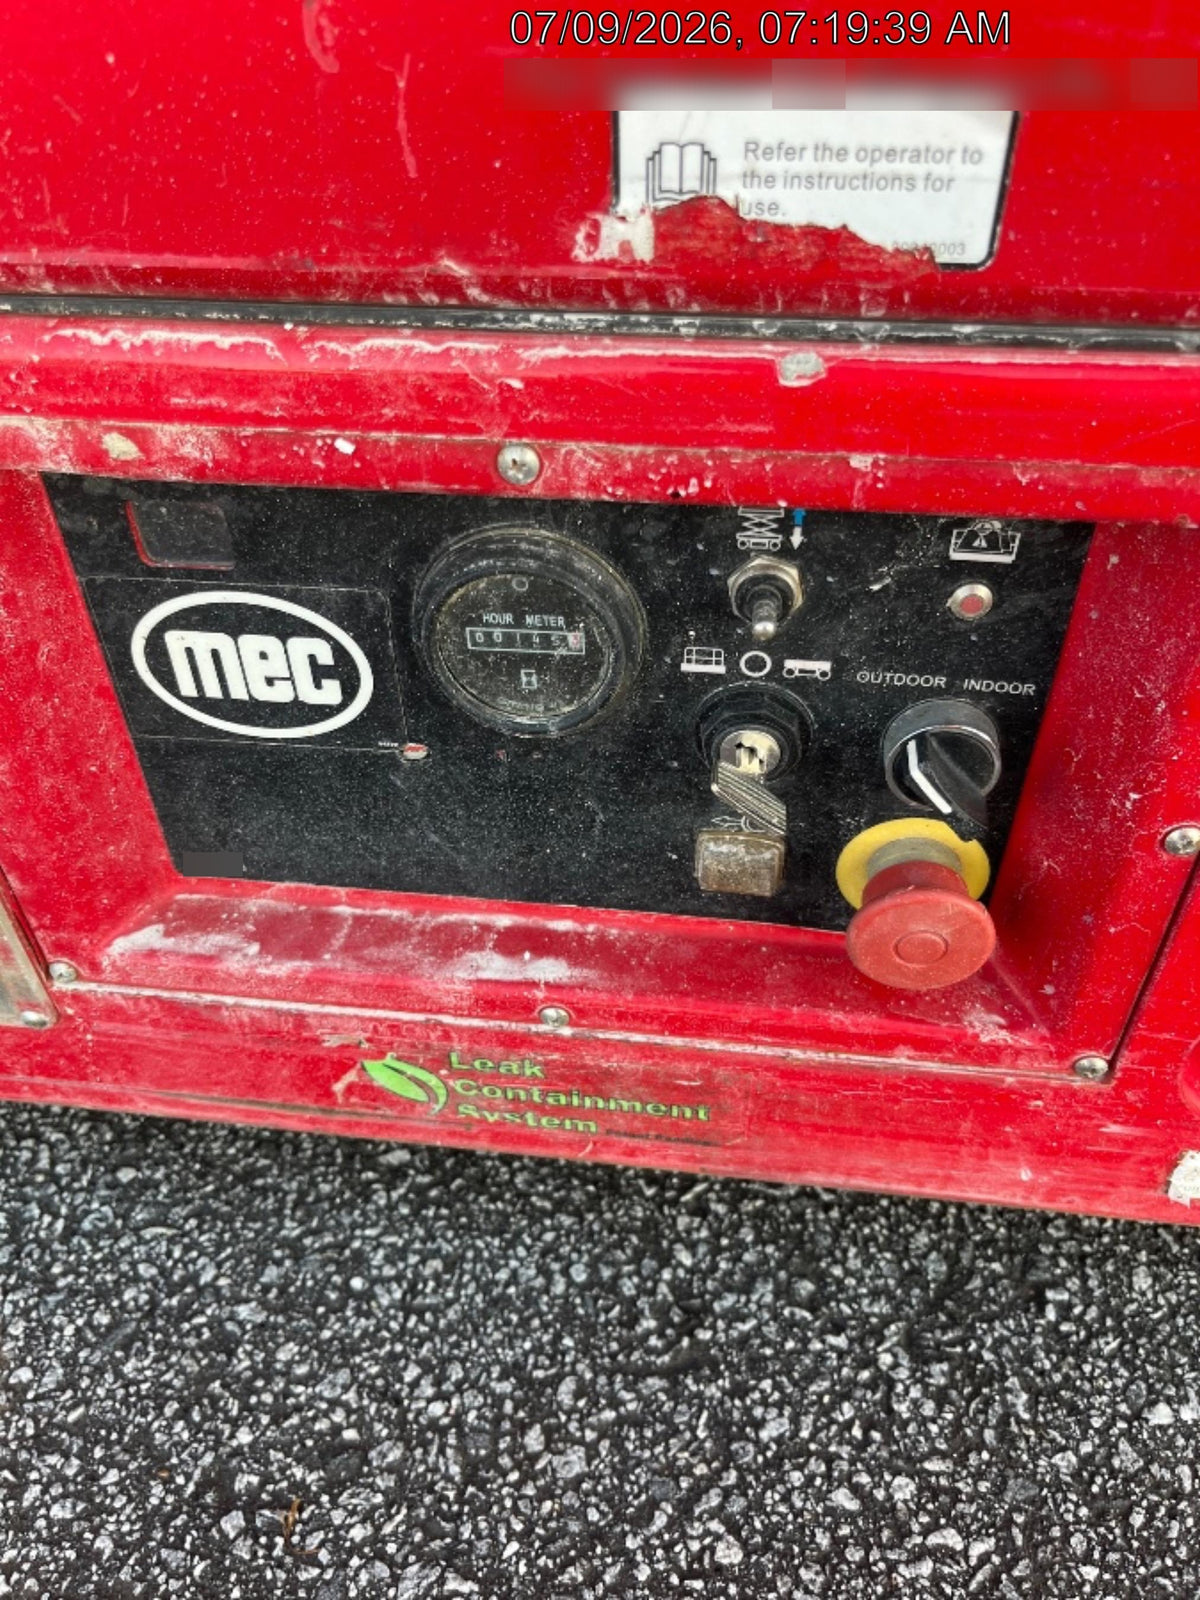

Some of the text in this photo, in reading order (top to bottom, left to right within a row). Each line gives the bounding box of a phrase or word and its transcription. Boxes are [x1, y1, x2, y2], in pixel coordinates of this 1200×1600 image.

[743, 141, 984, 168] Refer the operator to
[741, 170, 957, 192] the instructions for
[741, 199, 788, 217] use.
[482, 612, 566, 628] HOUR METER
[855, 670, 1037, 697] OUTDOOR INDOOR
[449, 1051, 546, 1079] Leak
[453, 1078, 712, 1121] Containment
[457, 1102, 599, 1134] System
